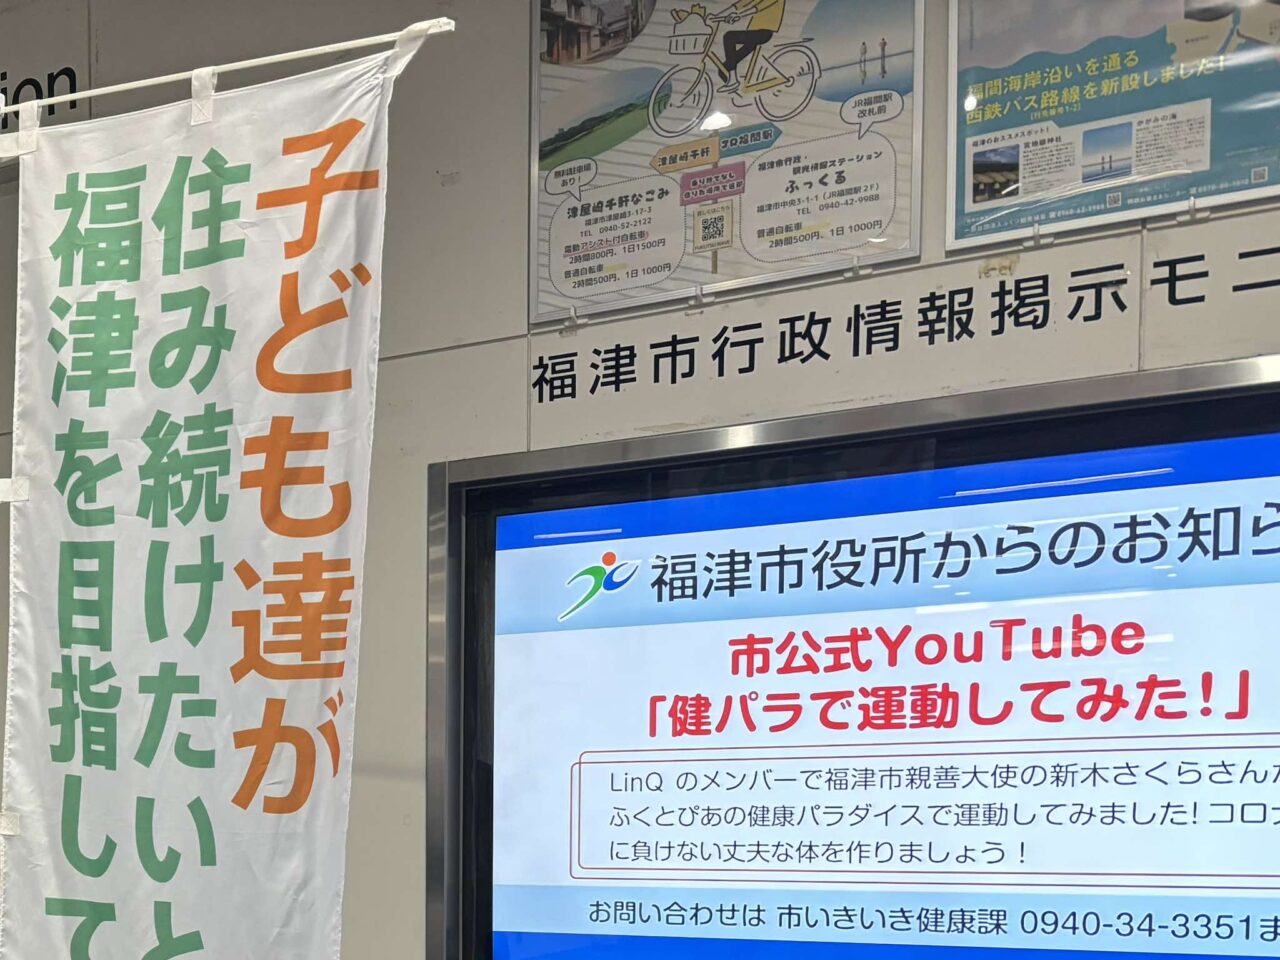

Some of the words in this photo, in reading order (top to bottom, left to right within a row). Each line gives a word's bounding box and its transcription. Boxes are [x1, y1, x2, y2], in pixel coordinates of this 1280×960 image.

[852, 93, 893, 108] JR福間駅
[785, 170, 847, 194] ふっくる
[532, 247, 1280, 404] 福津市行政情報掲示モニ
[230, 117, 380, 815] 子ども達が
[728, 613, 1146, 678] 市公式YouTube
[648, 669, 1250, 738] 「健パラで運動してみた！」
[610, 771, 664, 793] LinQ
[589, 900, 766, 928] お問い合わせは
[777, 903, 1008, 936] 市いきいき健康課
